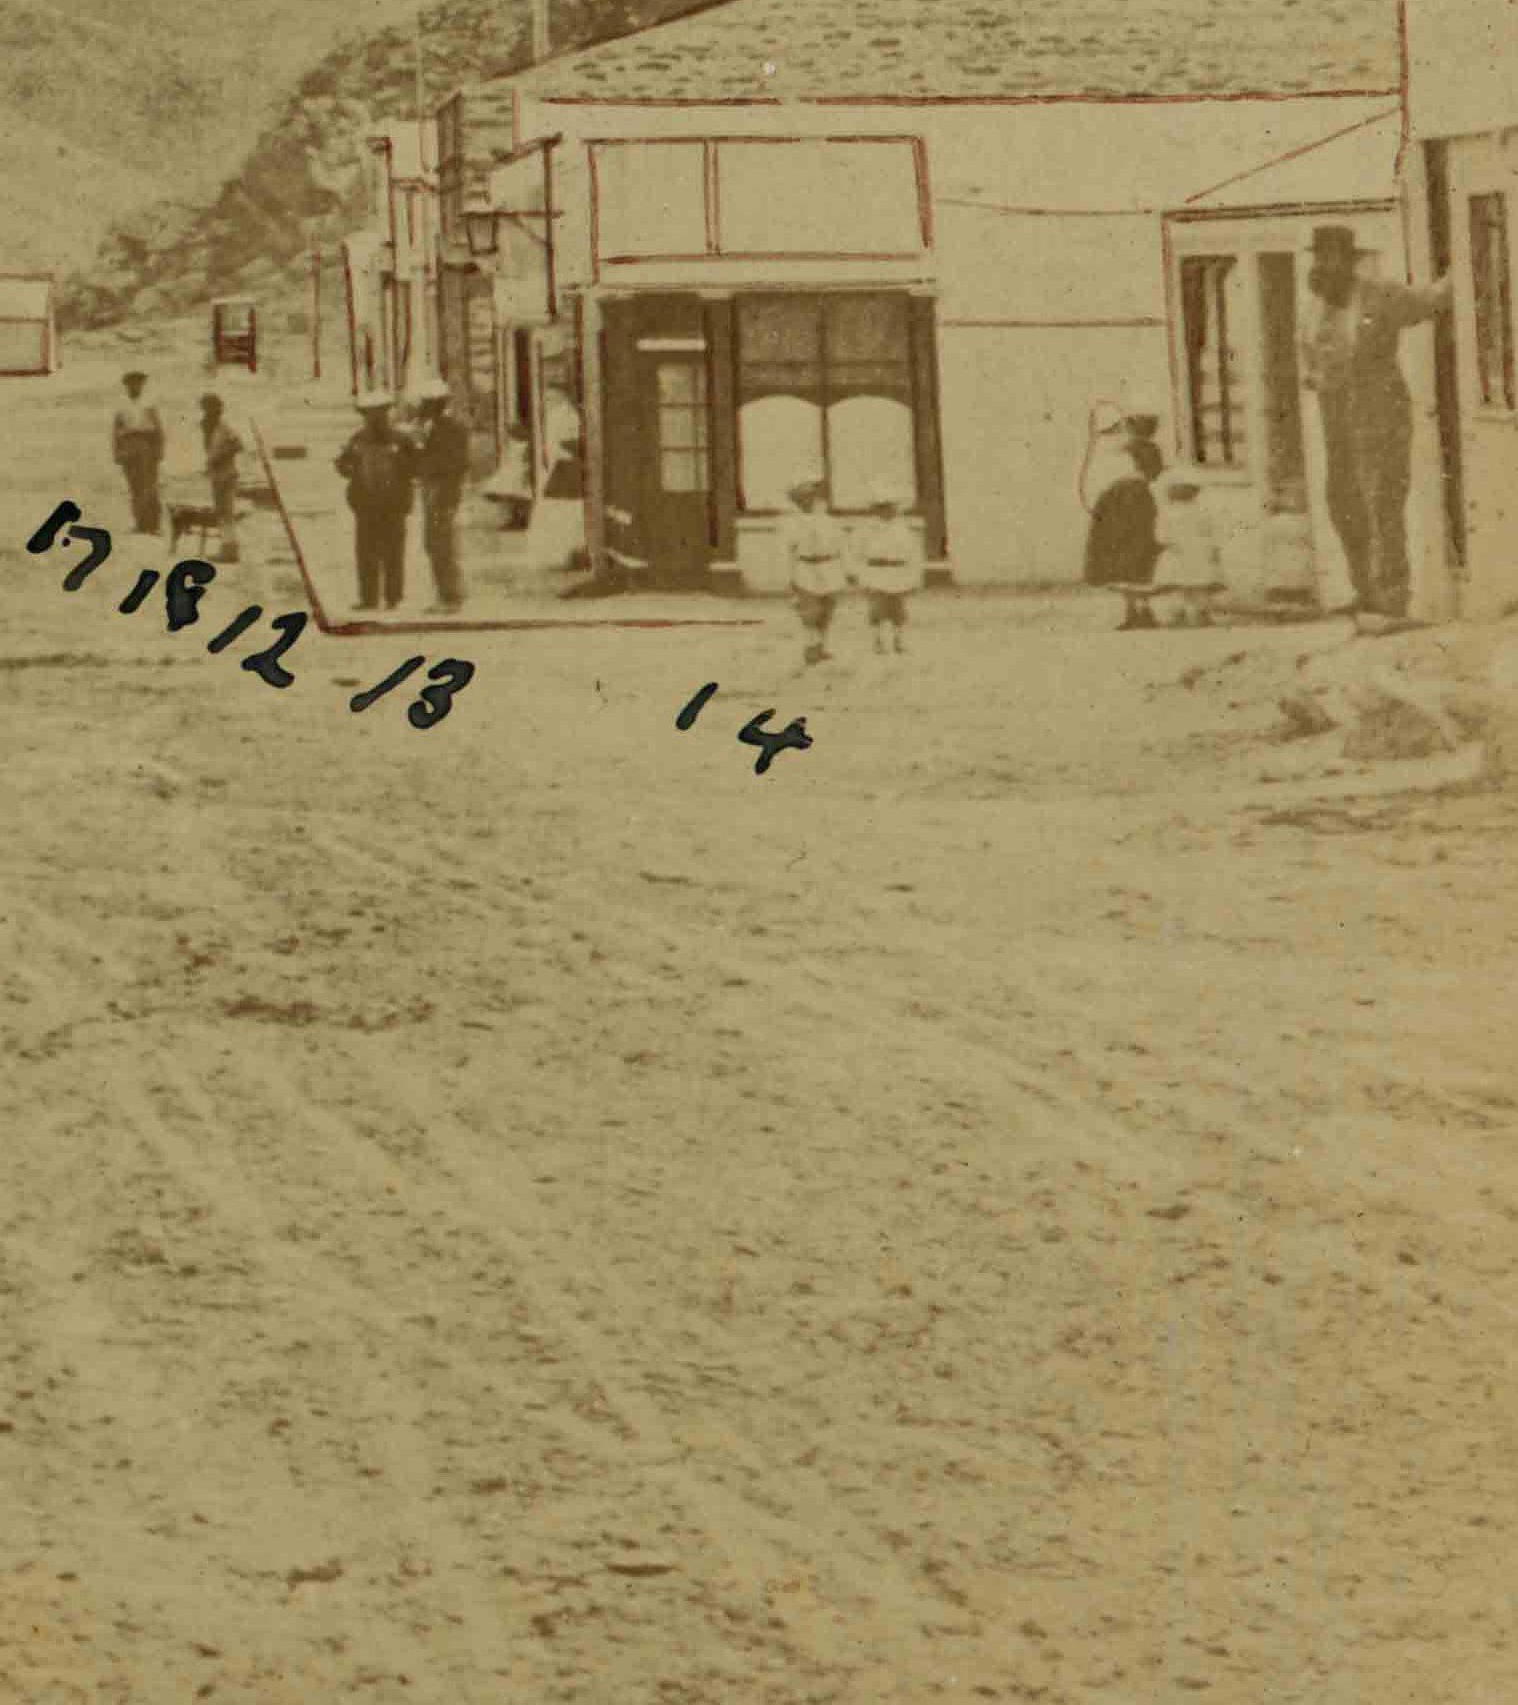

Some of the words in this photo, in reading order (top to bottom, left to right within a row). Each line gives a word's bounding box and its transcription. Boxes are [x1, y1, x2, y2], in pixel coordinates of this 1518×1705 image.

[209, 606, 305, 687] 12
[352, 658, 472, 729] 13
[677, 684, 810, 773] 14
